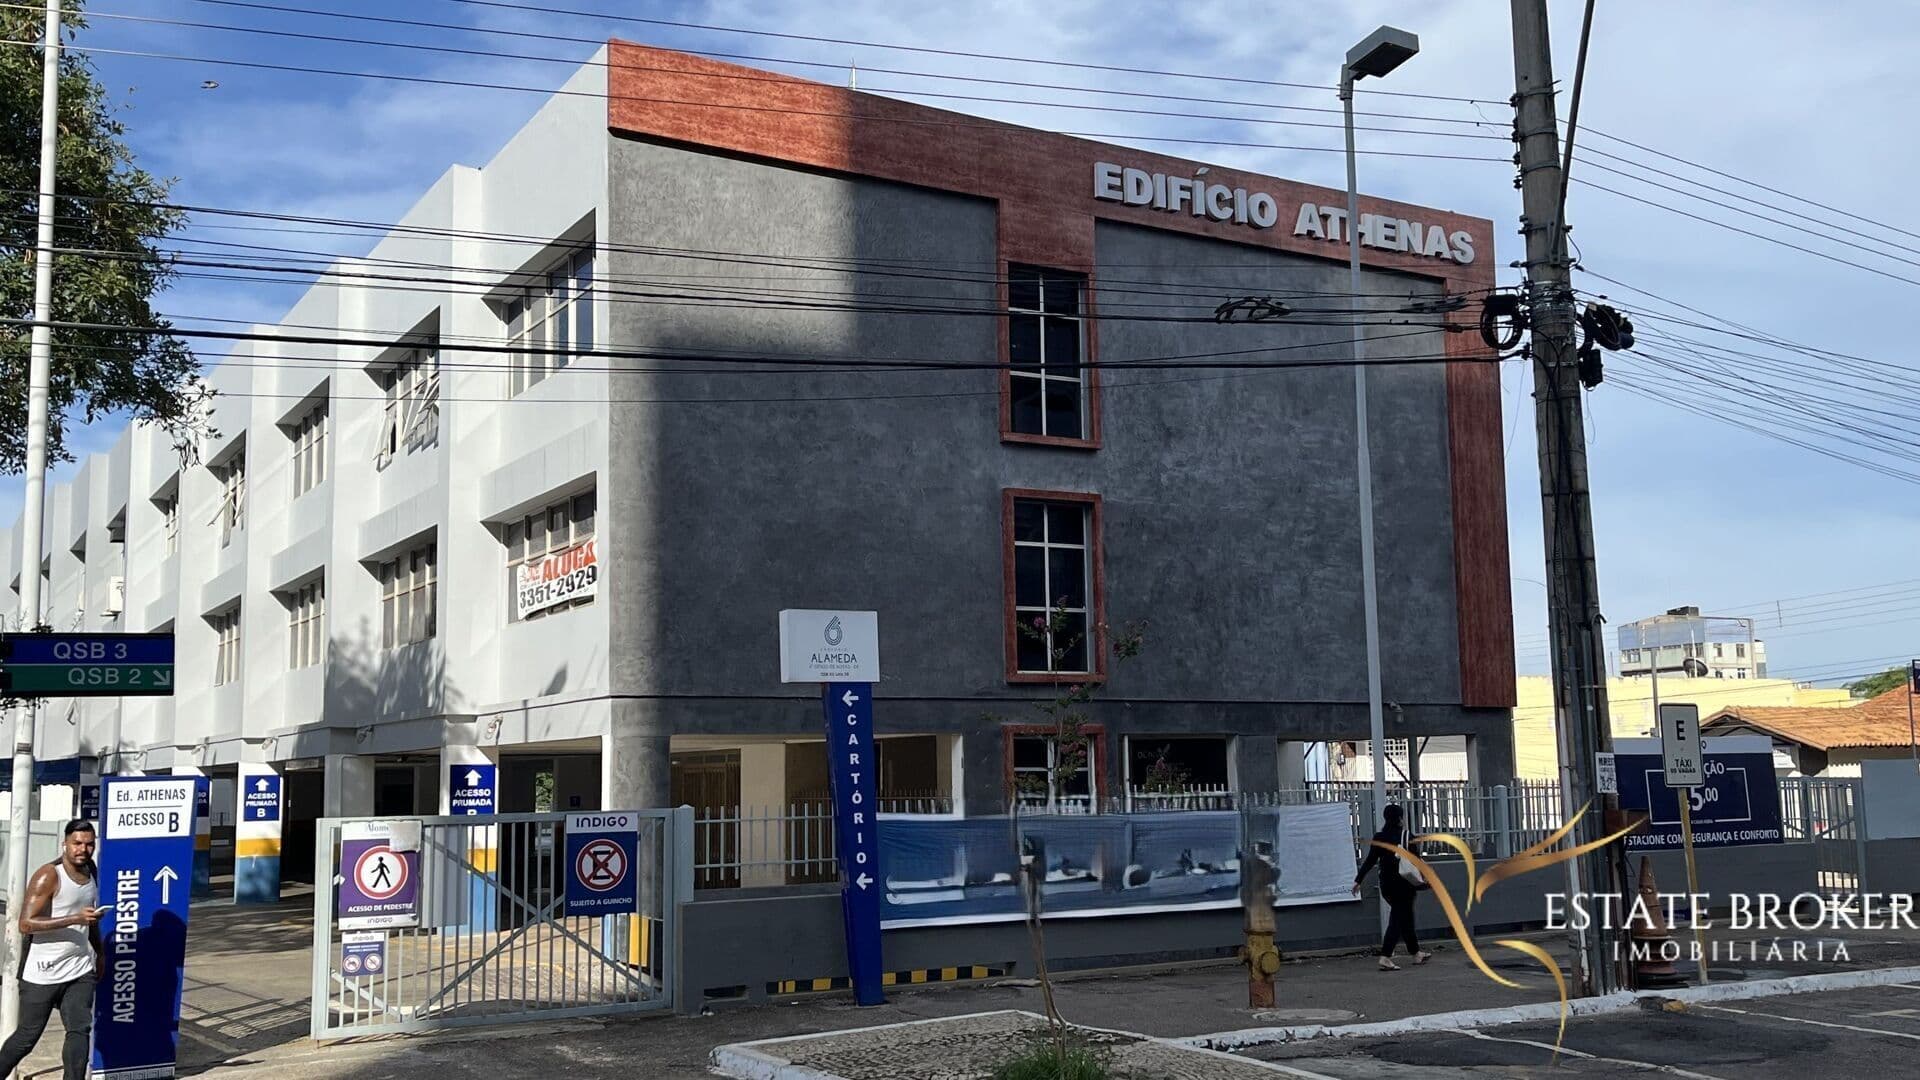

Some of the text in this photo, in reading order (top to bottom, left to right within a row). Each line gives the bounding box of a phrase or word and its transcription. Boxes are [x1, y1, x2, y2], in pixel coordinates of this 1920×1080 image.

[1094, 161, 1475, 265] EDIFÍCIO ATHENAS
[542, 541, 597, 583] ALUGA
[520, 565, 597, 609] 3351-2929
[53, 642, 128, 660] QSB 3
[811, 653, 857, 663] ALAMEDA
[68, 667, 142, 685] QSB 2
[1676, 720, 1686, 741] E
[1674, 757, 1692, 767] TÁXI
[117, 790, 132, 801] Ed.
[138, 789, 186, 800] ATHENAS
[455, 789, 491, 797] ACESSO
[847, 714, 867, 864] CARTÓRIO
[452, 799, 492, 807] PRUMADA
[257, 808, 266, 818] B
[118, 812, 179, 833] ACESSO B
[576, 816, 628, 828] INDIGO
[1691, 830, 1733, 843] EGURANÇA
[1734, 830, 1739, 840] E
[1740, 829, 1779, 841] CONFORTO
[603, 897, 632, 905] GUINCHO
[113, 869, 139, 1023] ACESSO PEDESTRE
